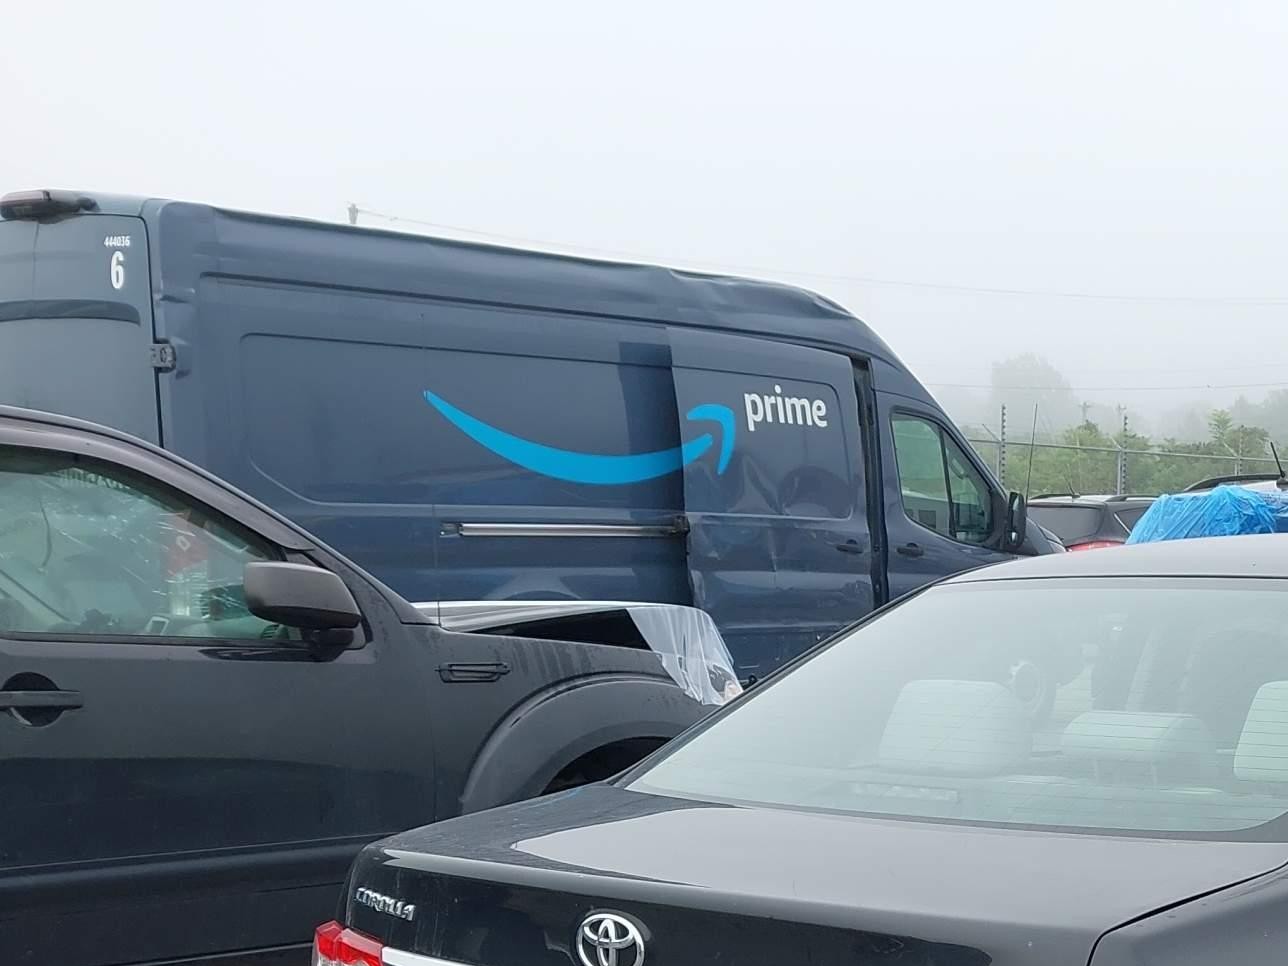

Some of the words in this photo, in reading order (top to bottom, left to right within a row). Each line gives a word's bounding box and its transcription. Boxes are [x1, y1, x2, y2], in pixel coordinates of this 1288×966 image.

[111, 250, 124, 289] 6
[744, 384, 828, 432] prime
[355, 887, 417, 921] COROLLA
